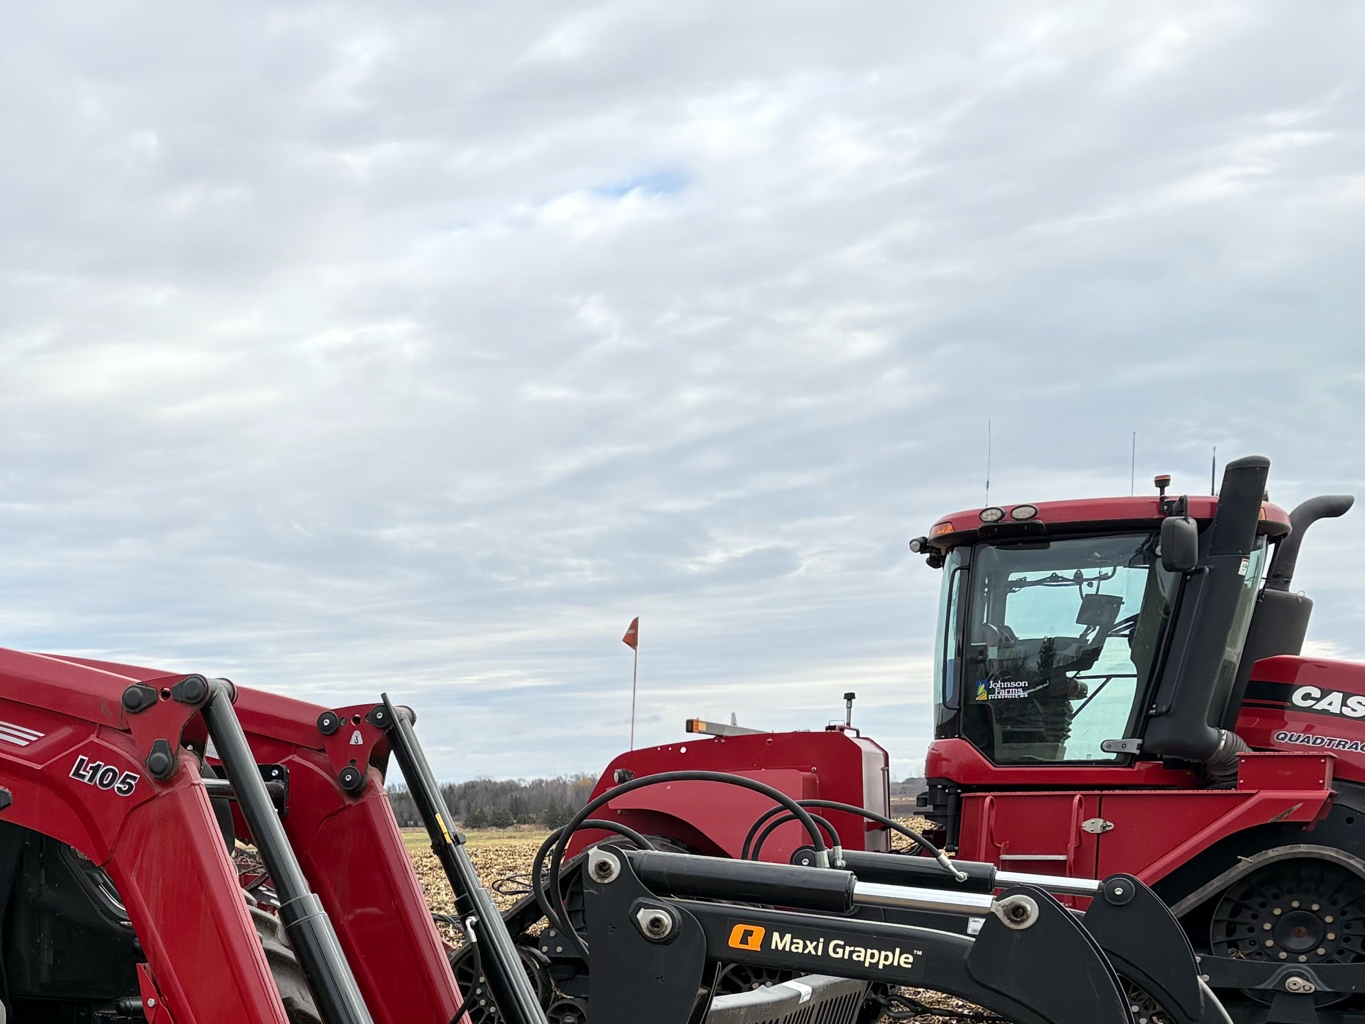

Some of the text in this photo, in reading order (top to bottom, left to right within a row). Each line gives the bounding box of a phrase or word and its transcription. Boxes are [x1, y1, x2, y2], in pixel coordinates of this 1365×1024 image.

[988, 680, 1029, 689] Johnson
[995, 687, 1023, 695] Farms
[1291, 685, 1365, 718] CAS
[69, 755, 140, 797] L105
[771, 931, 824, 956] Maxi
